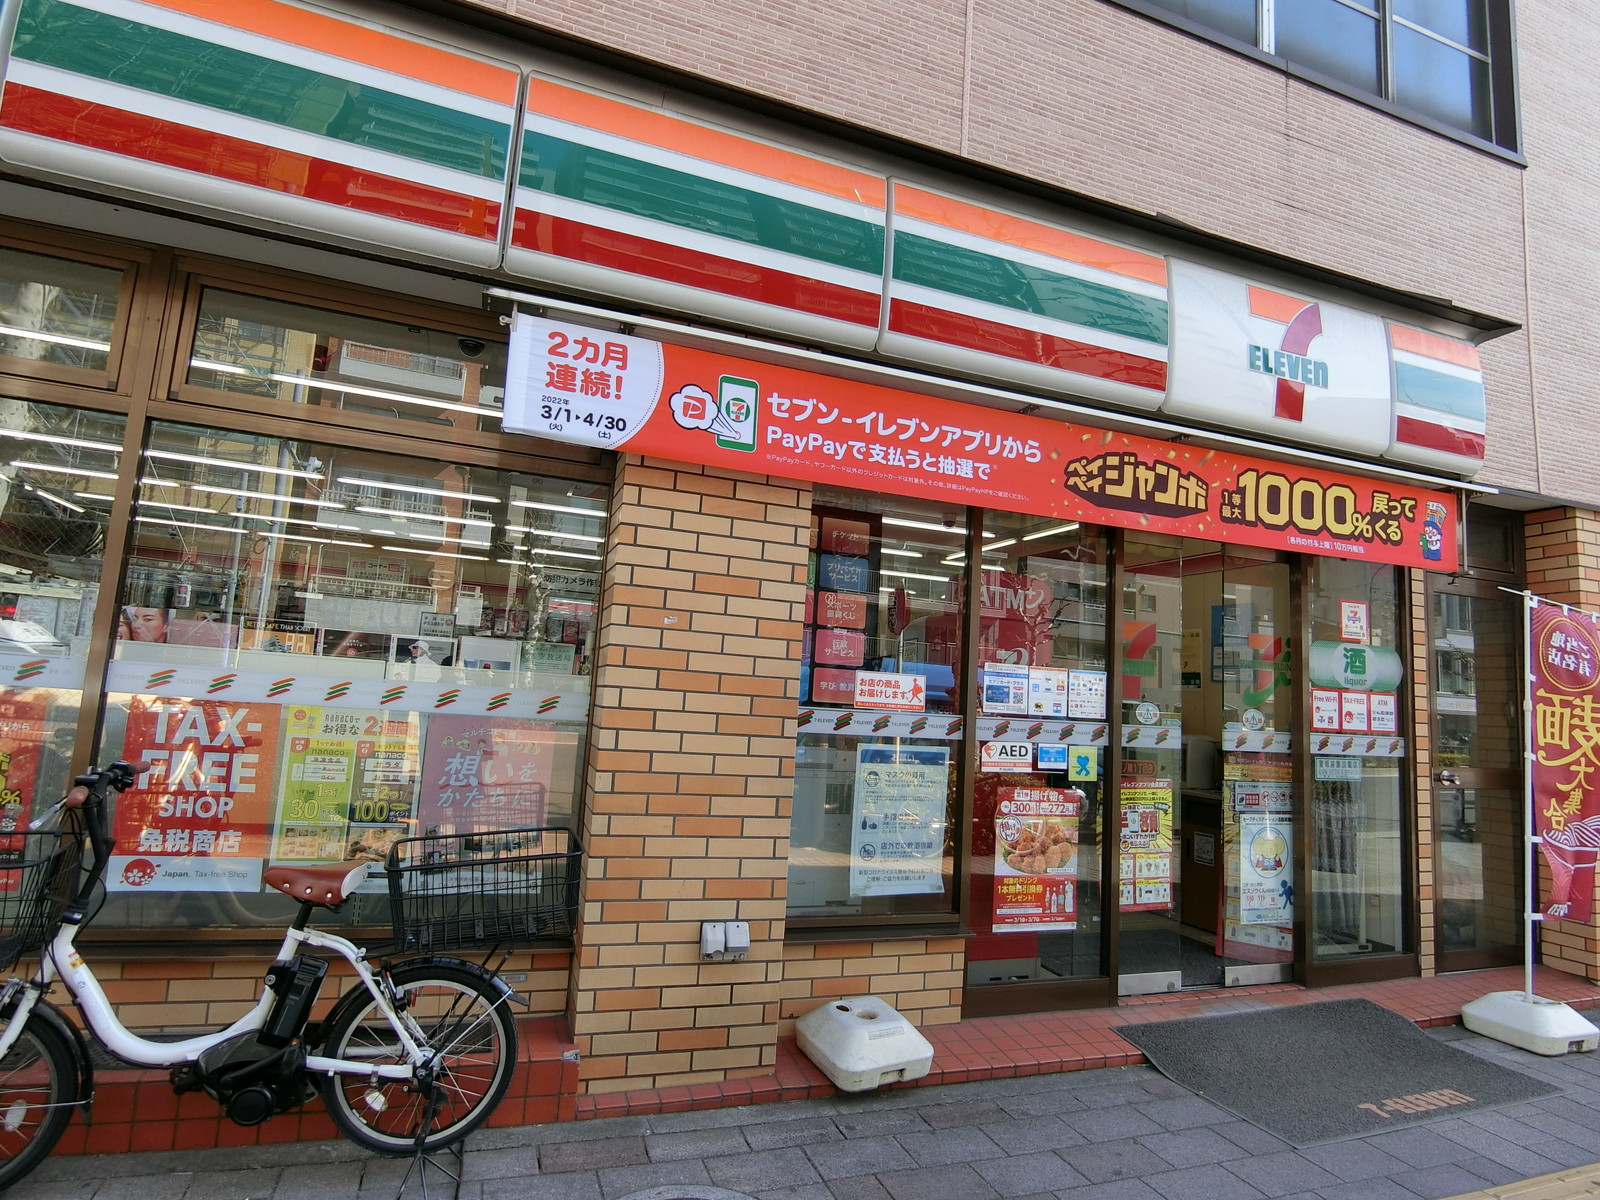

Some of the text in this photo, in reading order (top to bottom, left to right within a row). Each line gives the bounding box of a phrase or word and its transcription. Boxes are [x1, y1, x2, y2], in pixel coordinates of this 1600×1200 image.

[548, 331, 628, 371] 2カ月
[544, 361, 624, 400] 連続!
[541, 395, 570, 406] 2022年
[1372, 491, 1416, 518] 戻って
[828, 573, 858, 582] サービス
[824, 648, 854, 657] サービス
[1344, 646, 1367, 675] 酒
[859, 678, 900, 689] お店の商品
[1344, 676, 1368, 687] liquor
[323, 723, 359, 735] お得な
[998, 745, 1029, 758] AED
[137, 749, 260, 793] FREE
[438, 751, 539, 786] 想いを
[158, 796, 234, 818] SHOP
[437, 787, 535, 807] かたちに
[138, 828, 243, 853] 免税商店
[228, 870, 248, 880] Shop
